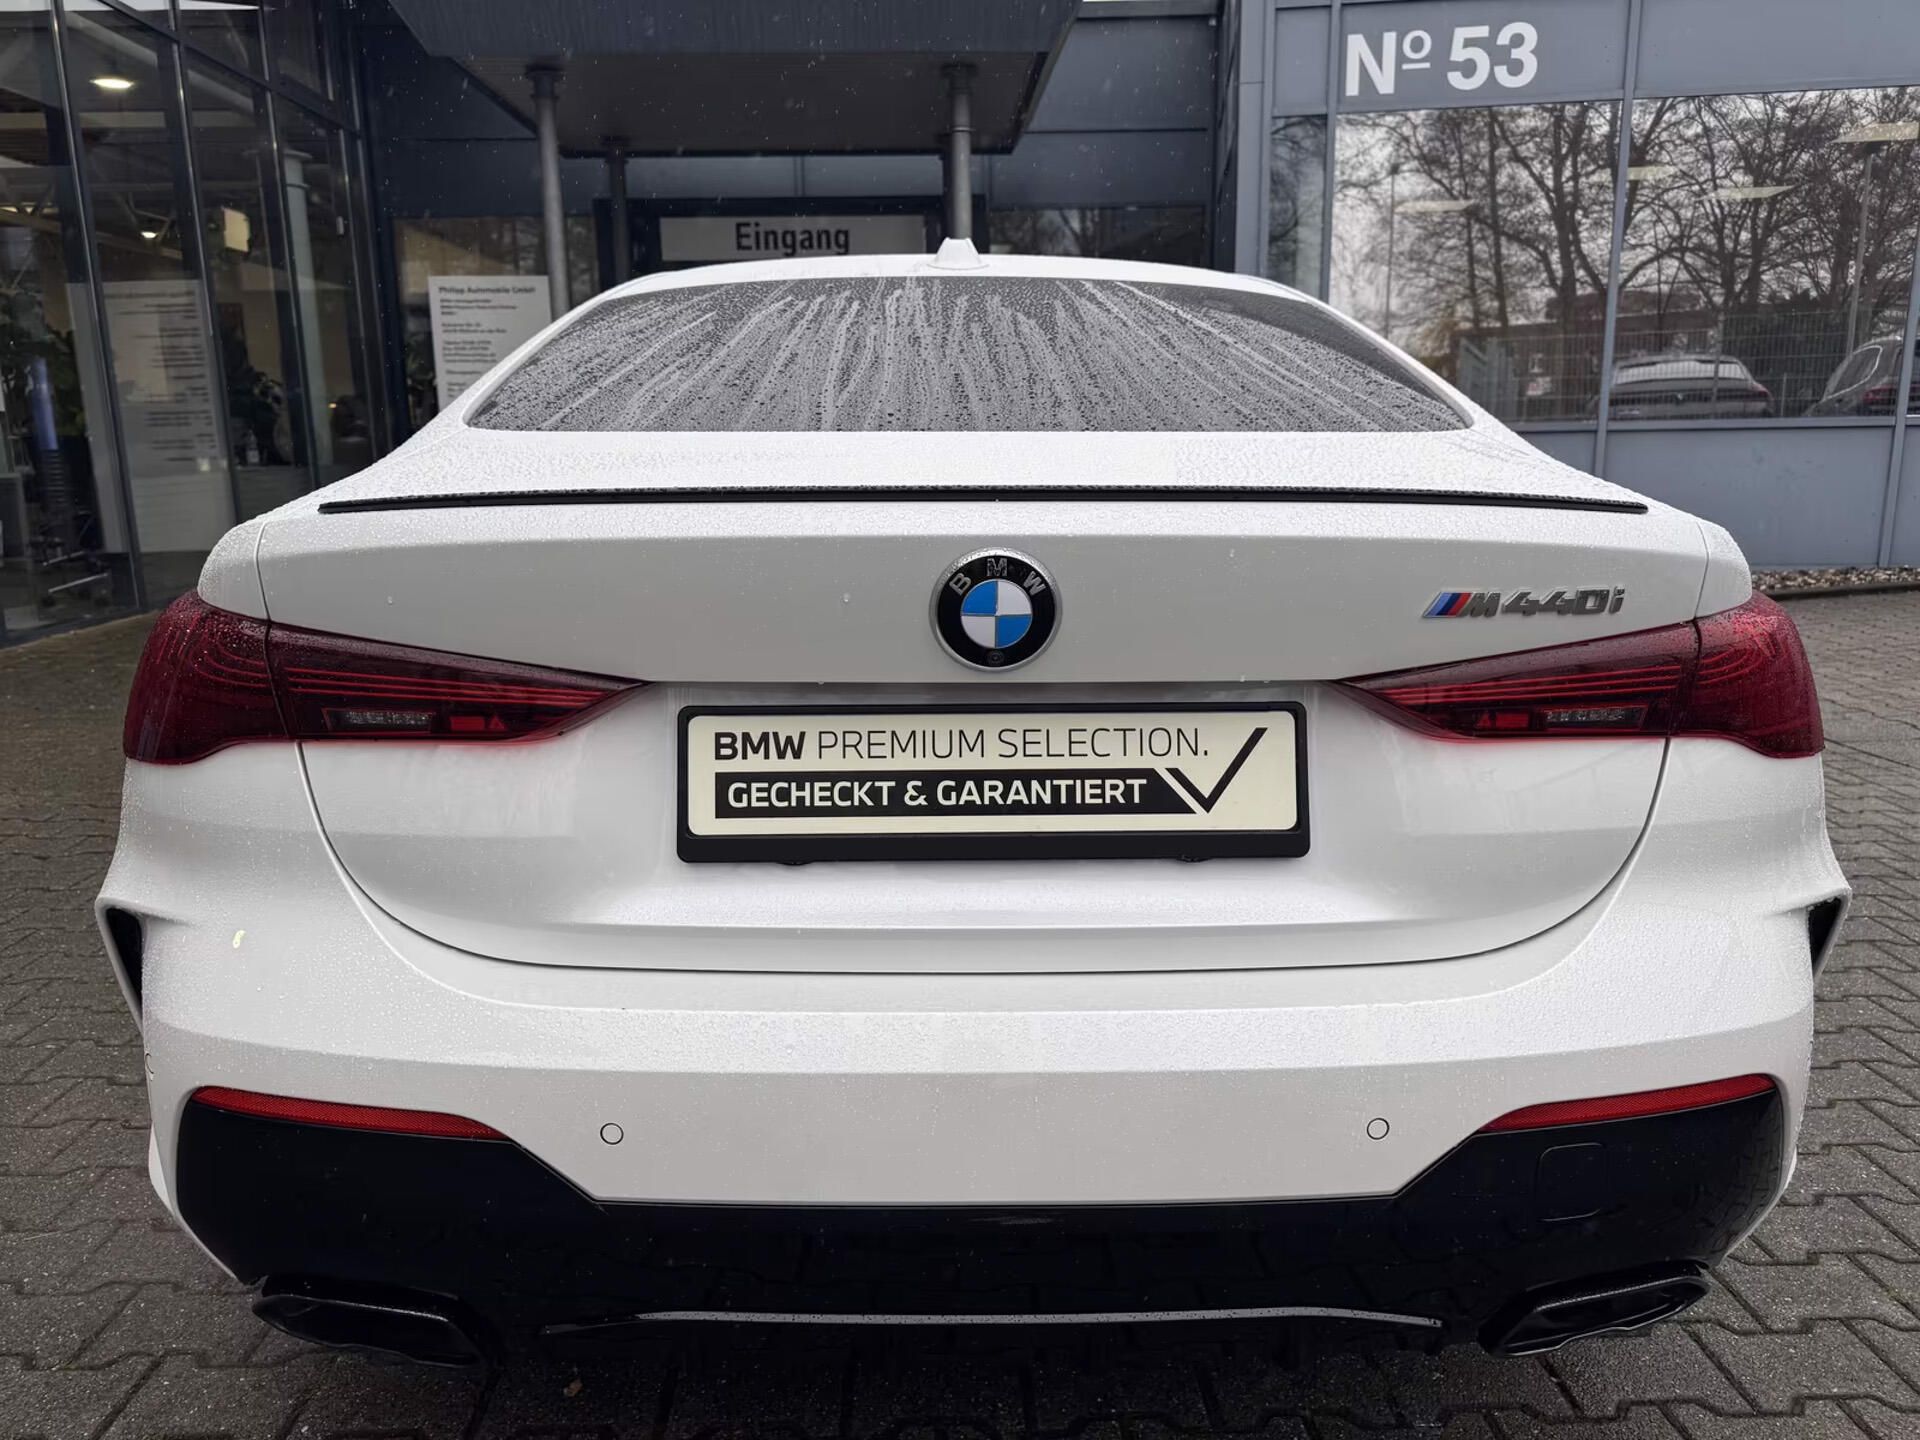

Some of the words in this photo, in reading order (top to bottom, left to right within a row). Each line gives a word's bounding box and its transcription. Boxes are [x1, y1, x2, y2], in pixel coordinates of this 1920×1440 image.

[1446, 21, 1538, 91] 53
[735, 222, 850, 257] Eingang
[948, 557, 1046, 597] BMW
[1454, 585, 1626, 618] M440i
[714, 731, 806, 760] BMW
[818, 728, 985, 759] PREMIUM
[997, 727, 1208, 758] SELECTION.
[727, 780, 896, 808] GECHECKT
[903, 780, 928, 806] &
[936, 778, 1147, 806] GARANTIERT
